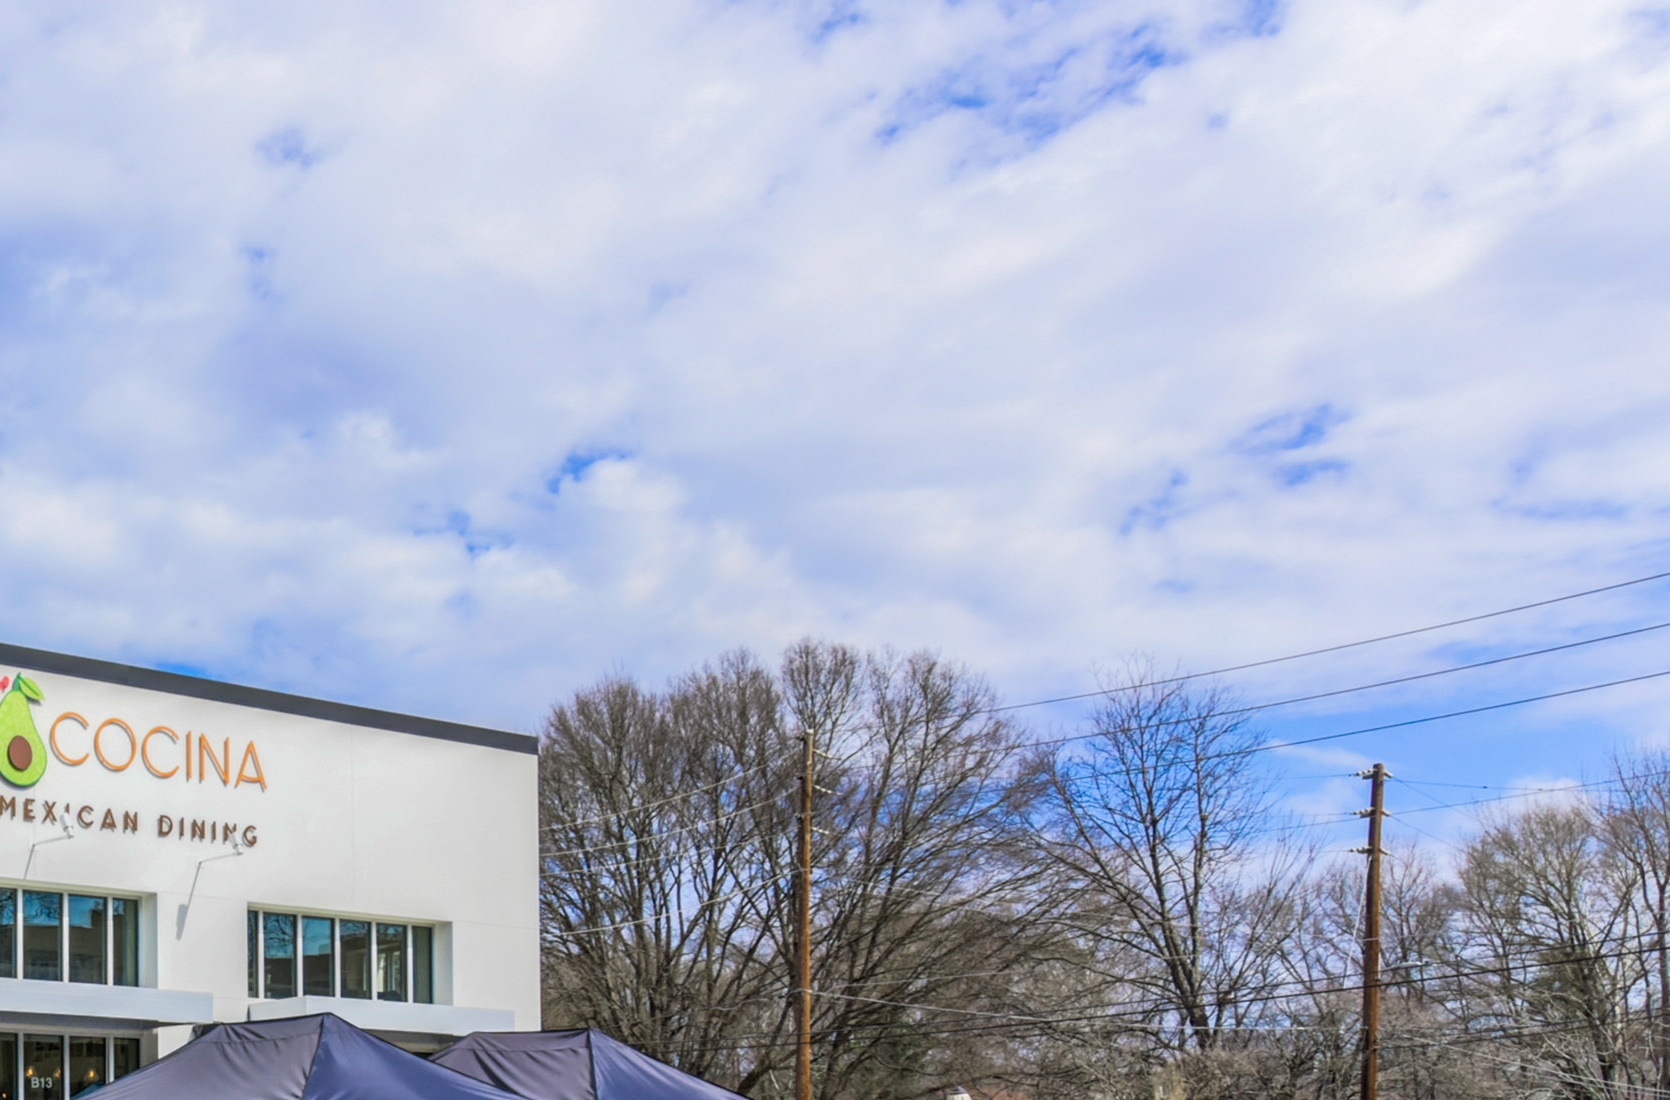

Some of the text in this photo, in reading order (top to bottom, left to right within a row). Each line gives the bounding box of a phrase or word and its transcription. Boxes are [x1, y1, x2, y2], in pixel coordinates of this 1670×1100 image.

[50, 711, 267, 790] COCINA
[158, 814, 257, 846] DINING
[31, 1076, 53, 1089] B13
